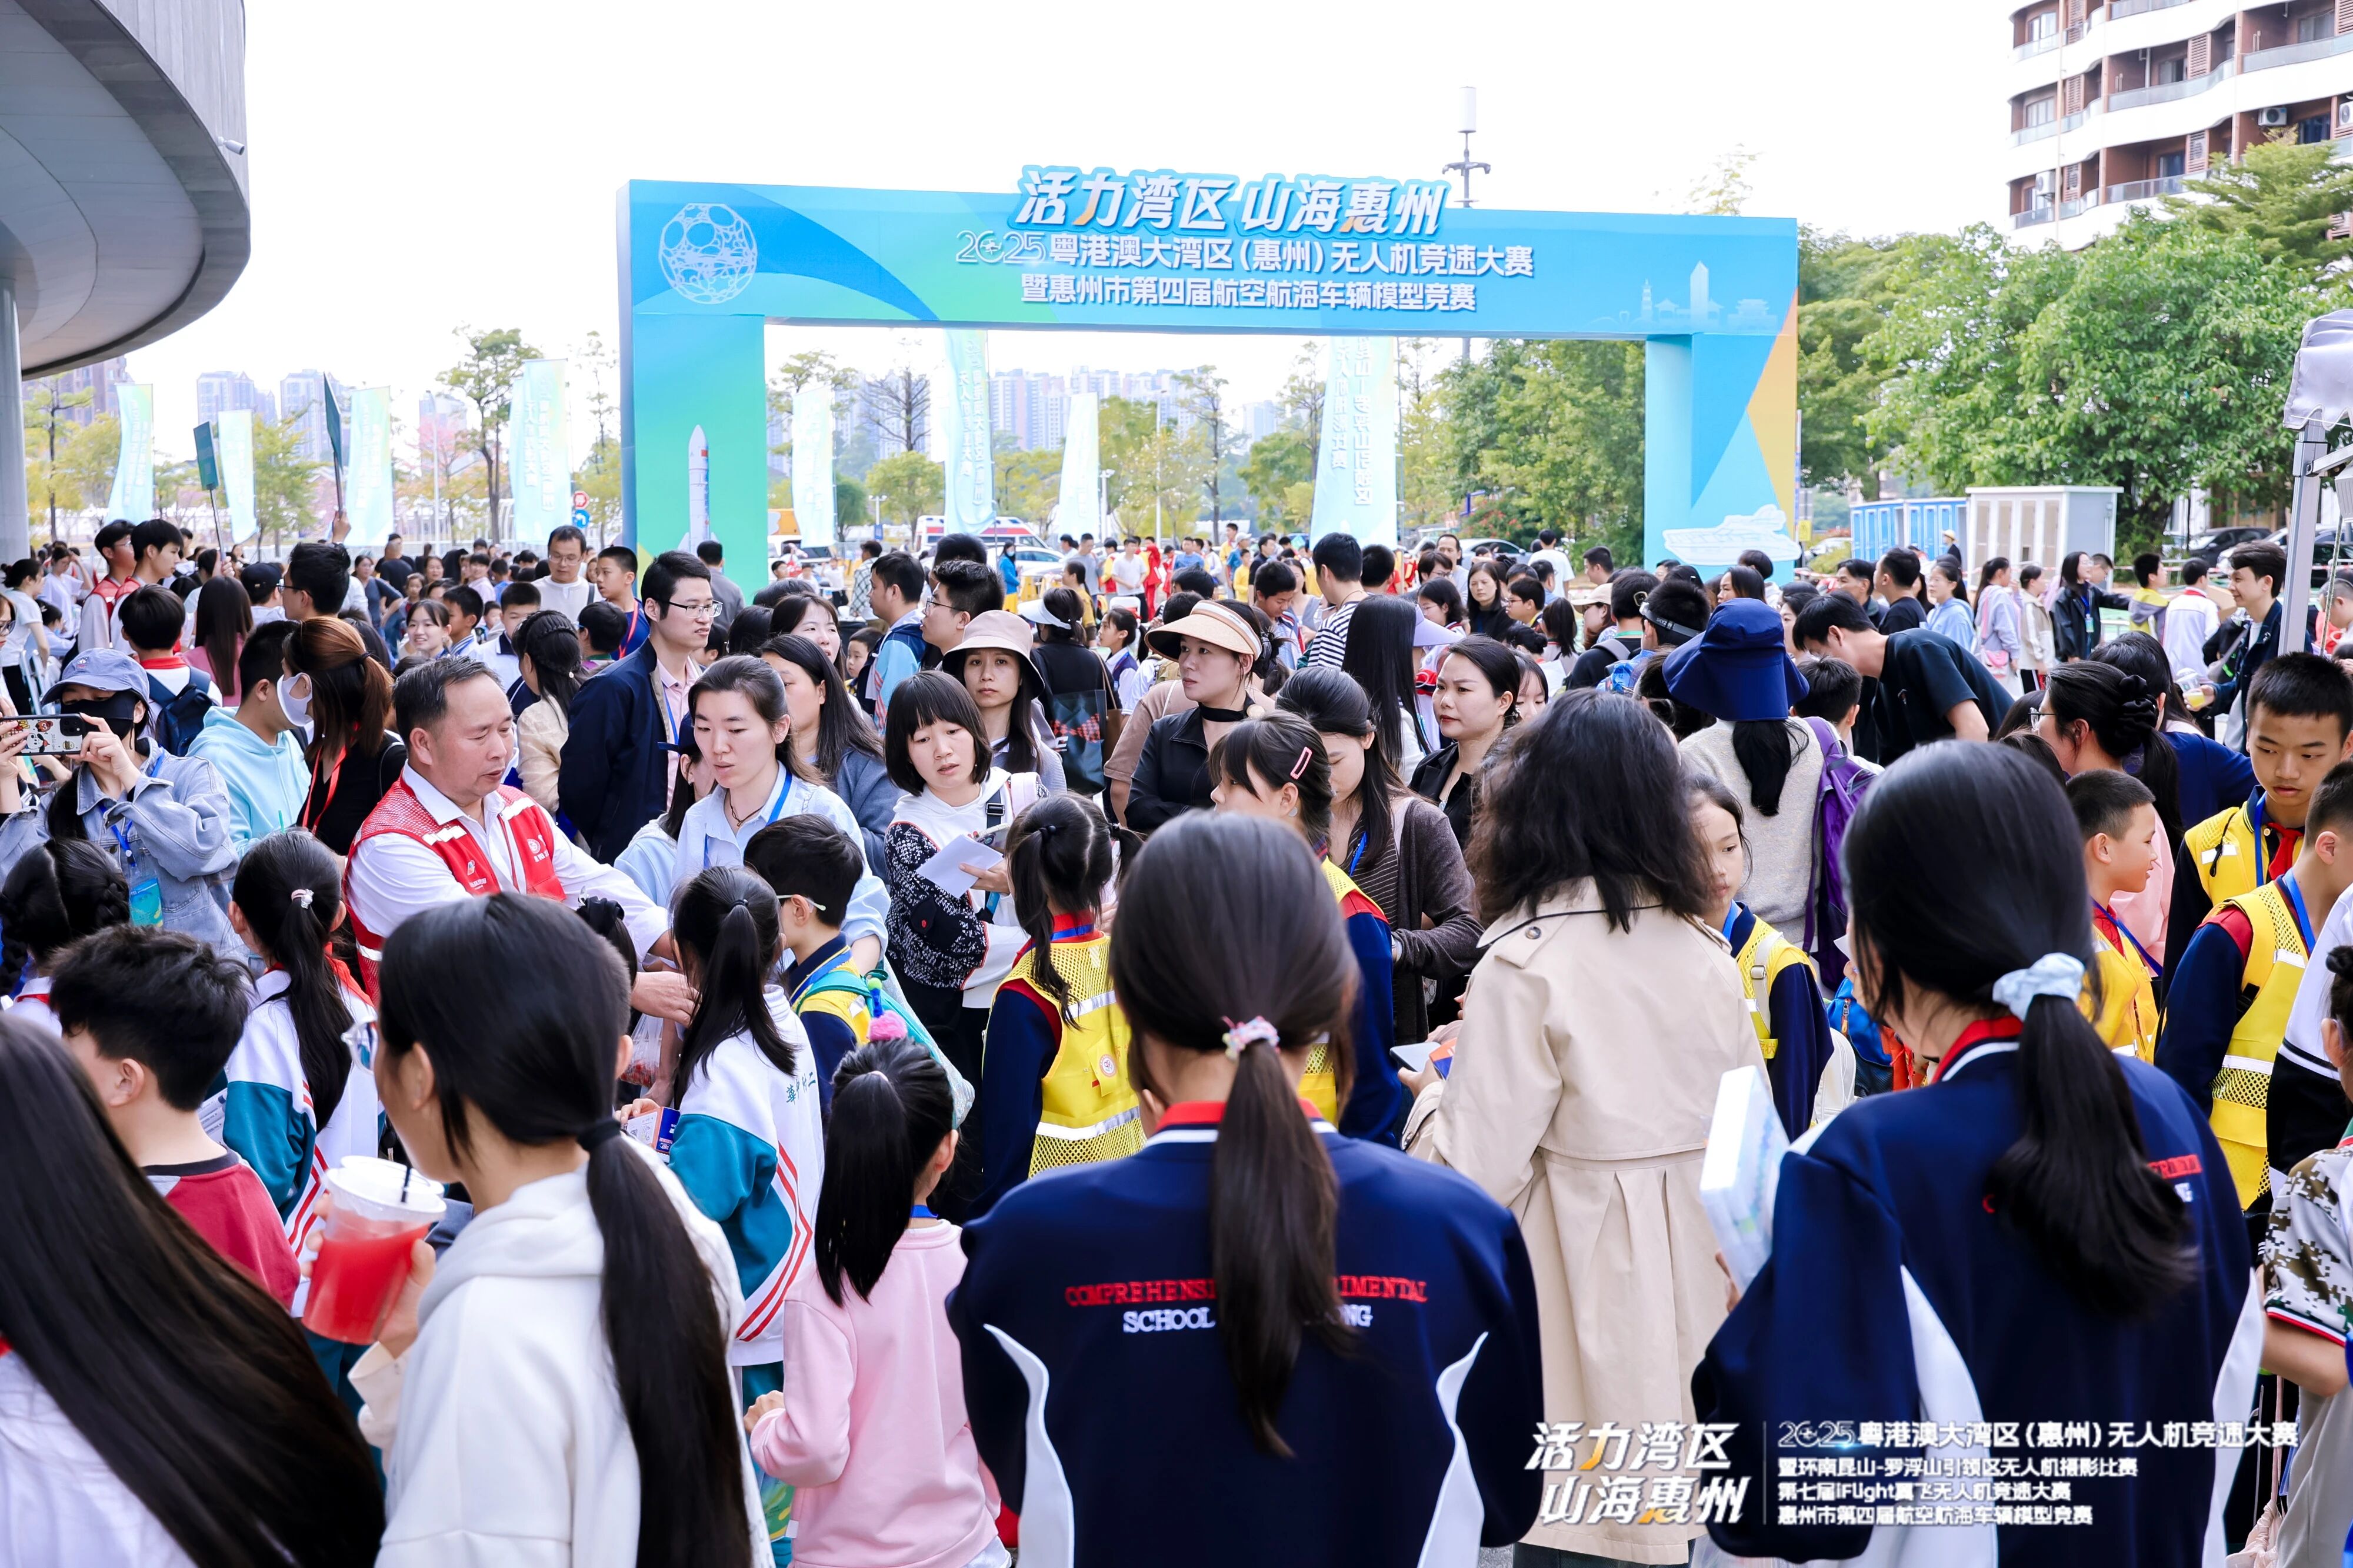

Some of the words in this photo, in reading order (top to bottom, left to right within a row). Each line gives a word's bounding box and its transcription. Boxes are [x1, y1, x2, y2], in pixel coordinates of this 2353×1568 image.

[1015, 170, 1235, 230] 活力湾区
[1241, 179, 1449, 235] 山海惠州
[1021, 273, 1476, 312] 暨惠州市第四届航空航海车辆模型竞赛
[1065, 1278, 1218, 1307] COMPREHENSI
[1337, 1275, 1429, 1303] IMENTAL
[1124, 1307, 1216, 1333] SCHOOL
